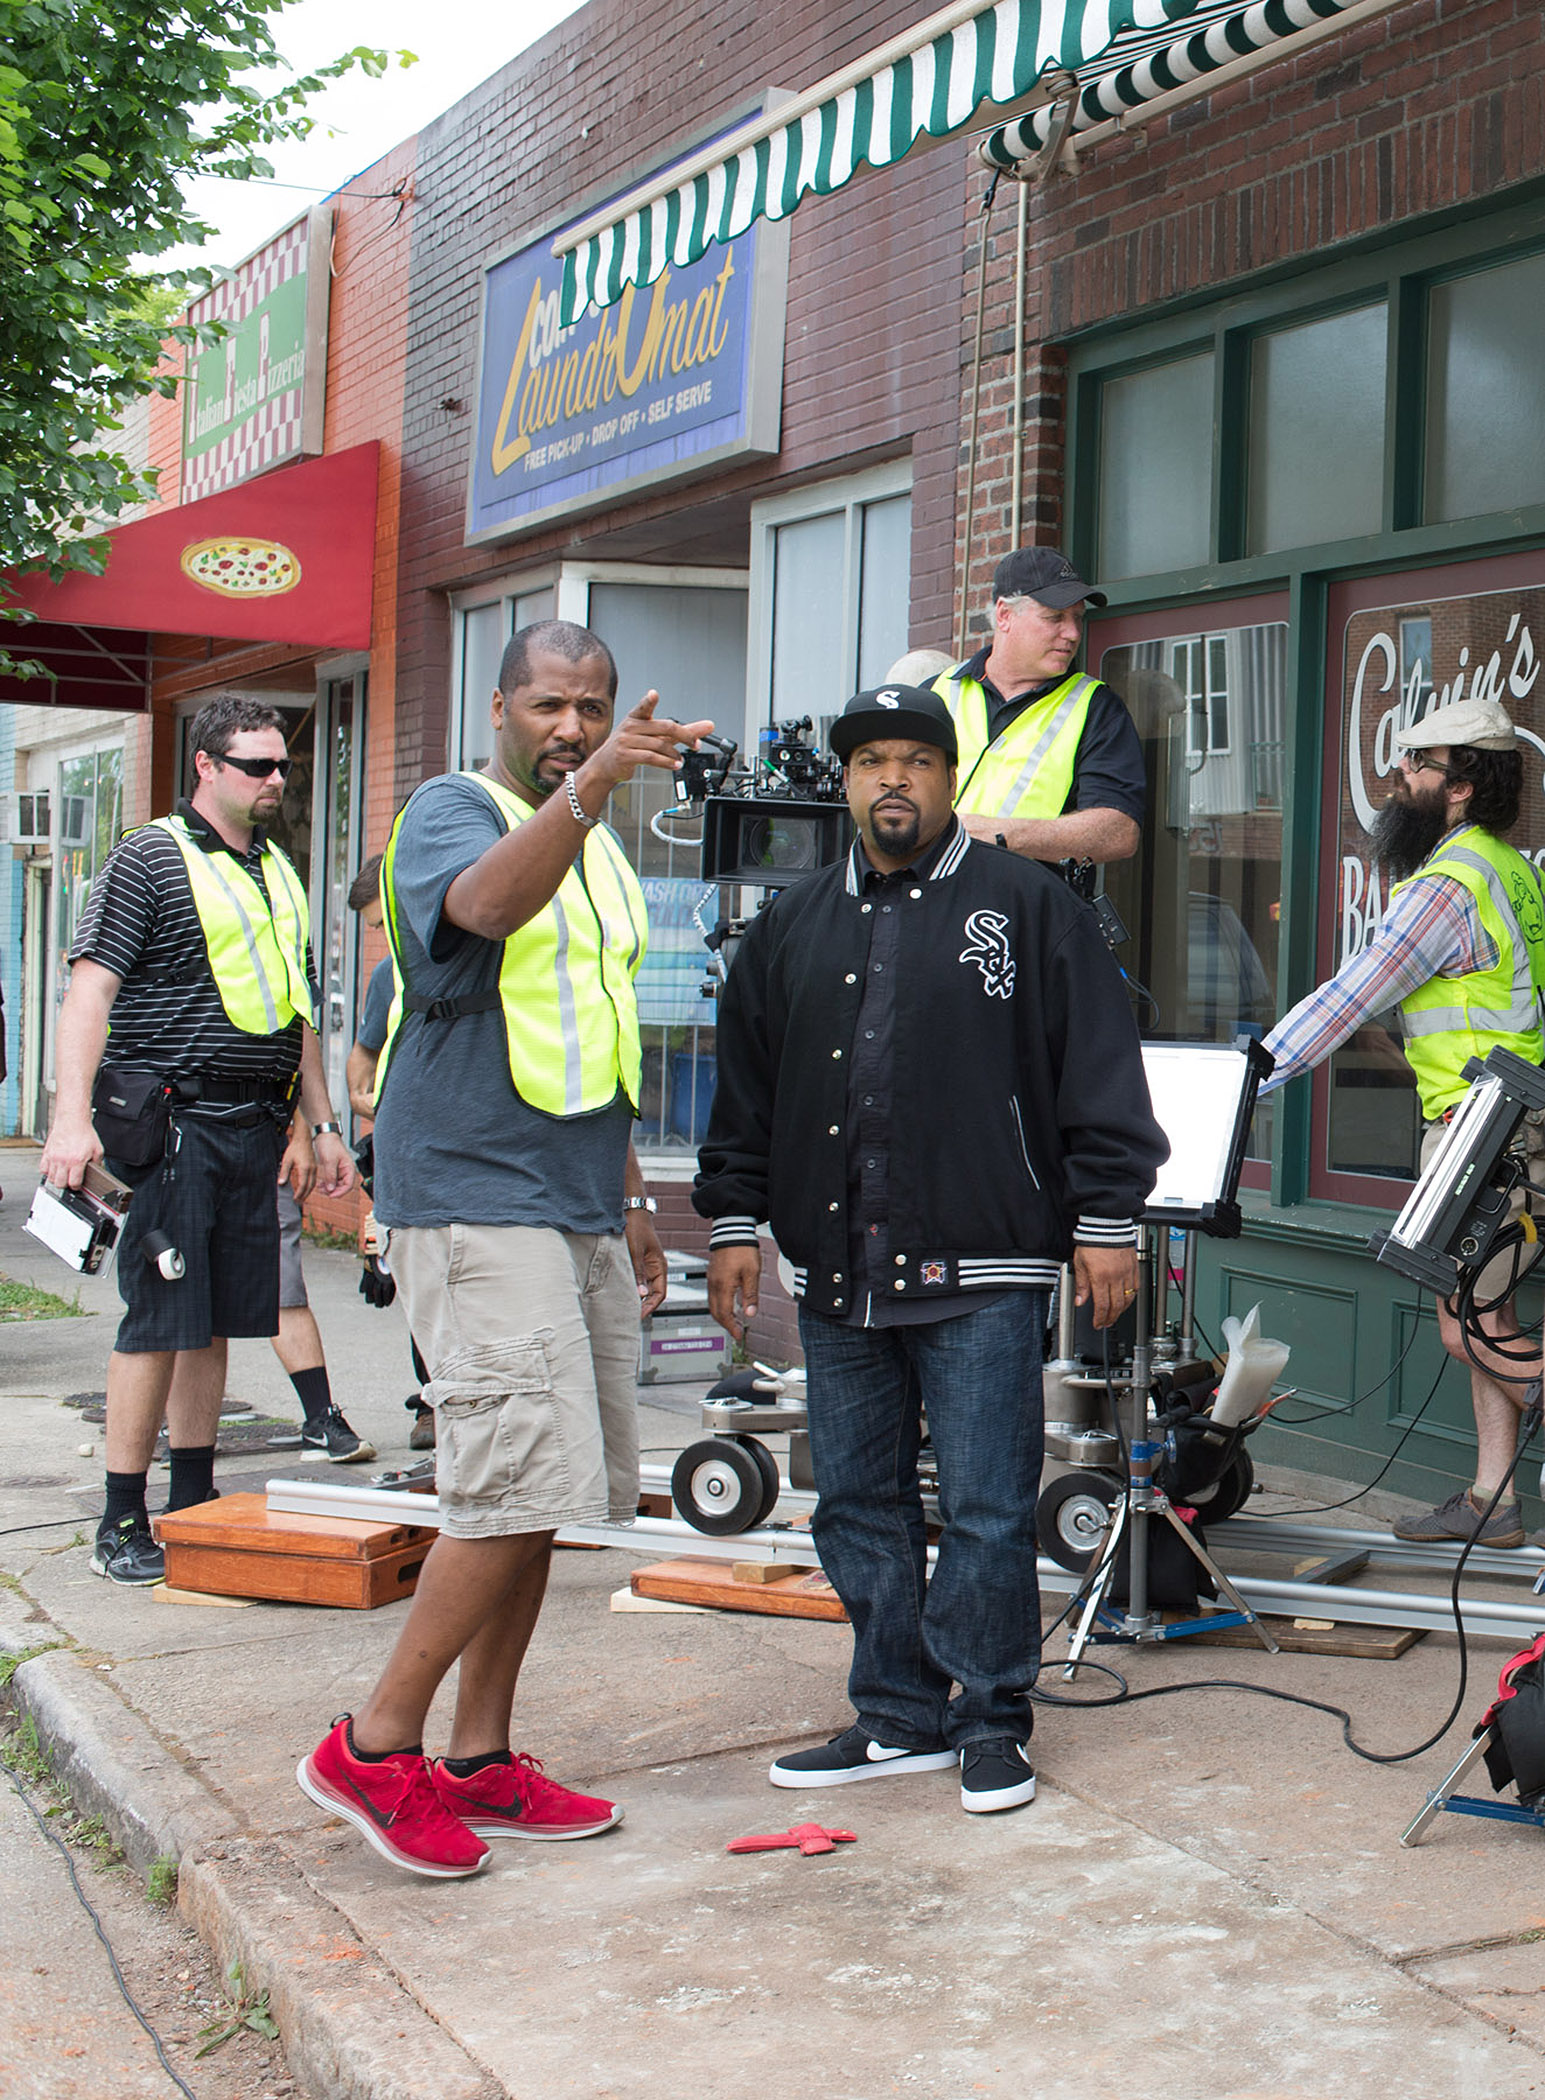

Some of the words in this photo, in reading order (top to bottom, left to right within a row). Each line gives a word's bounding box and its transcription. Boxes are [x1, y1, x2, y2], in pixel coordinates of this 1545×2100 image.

[188, 361, 225, 446] Italian
[224, 335, 257, 427] Fiesta
[257, 310, 305, 406] Pizzeria
[524, 446, 548, 473] FREE
[547, 432, 584, 462] PICK-UP
[591, 419, 618, 447] DROP
[619, 409, 640, 437] OFF
[647, 394, 673, 425] SELF
[674, 379, 712, 414] SERVE
